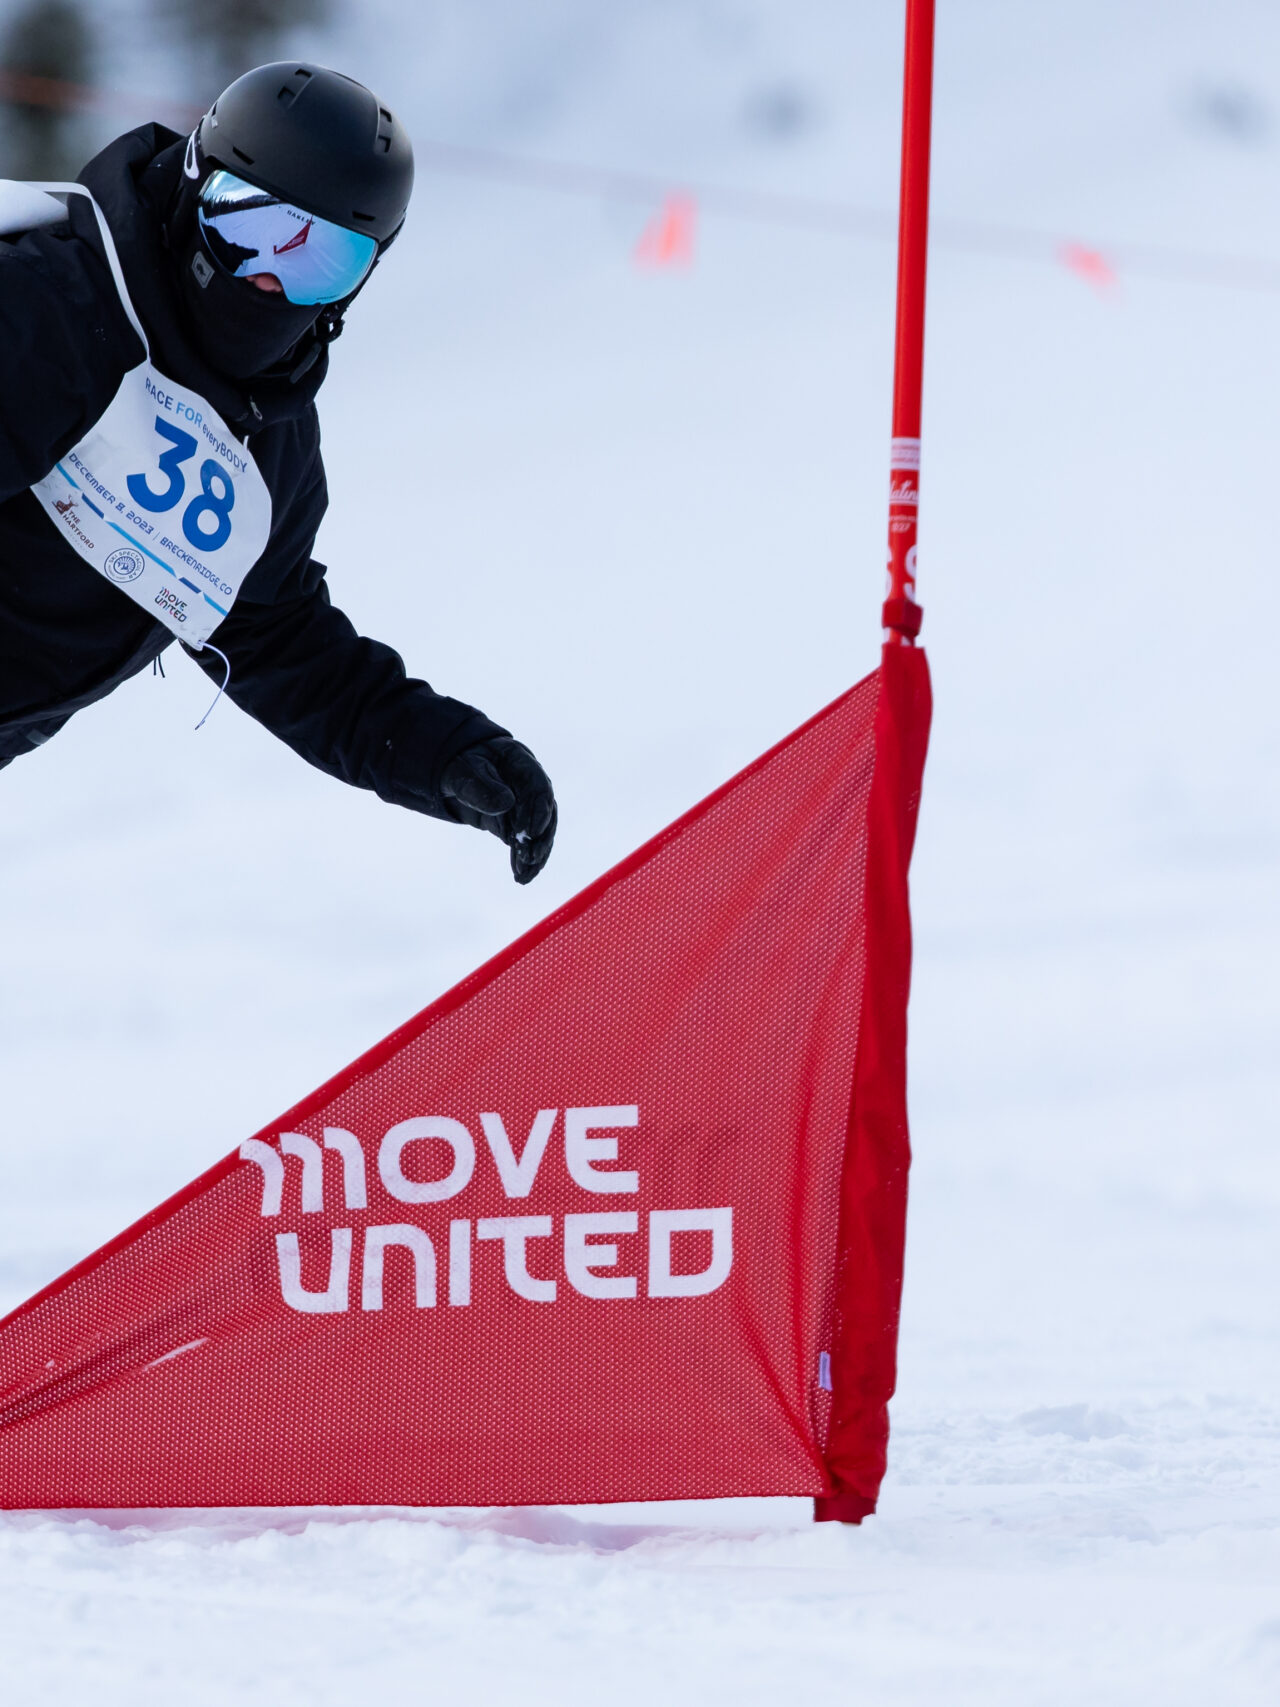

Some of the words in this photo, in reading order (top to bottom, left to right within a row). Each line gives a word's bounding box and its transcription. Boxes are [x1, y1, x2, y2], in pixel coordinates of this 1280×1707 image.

[145, 377, 174, 411] RACE
[176, 401, 203, 428] FOR
[202, 423, 248, 473] everyBODY
[68, 453, 116, 504] DECEMBER
[115, 502, 126, 514] 8,
[125, 510, 155, 535] 2023
[68, 510, 81, 524] THE
[126, 415, 235, 552] 38
[62, 514, 95, 549] HARTFORD
[154, 595, 188, 623] UNITED
[159, 586, 188, 612] MOVE
[239, 1104, 639, 1217] MOVE
[275, 1206, 733, 1314] UNITED
